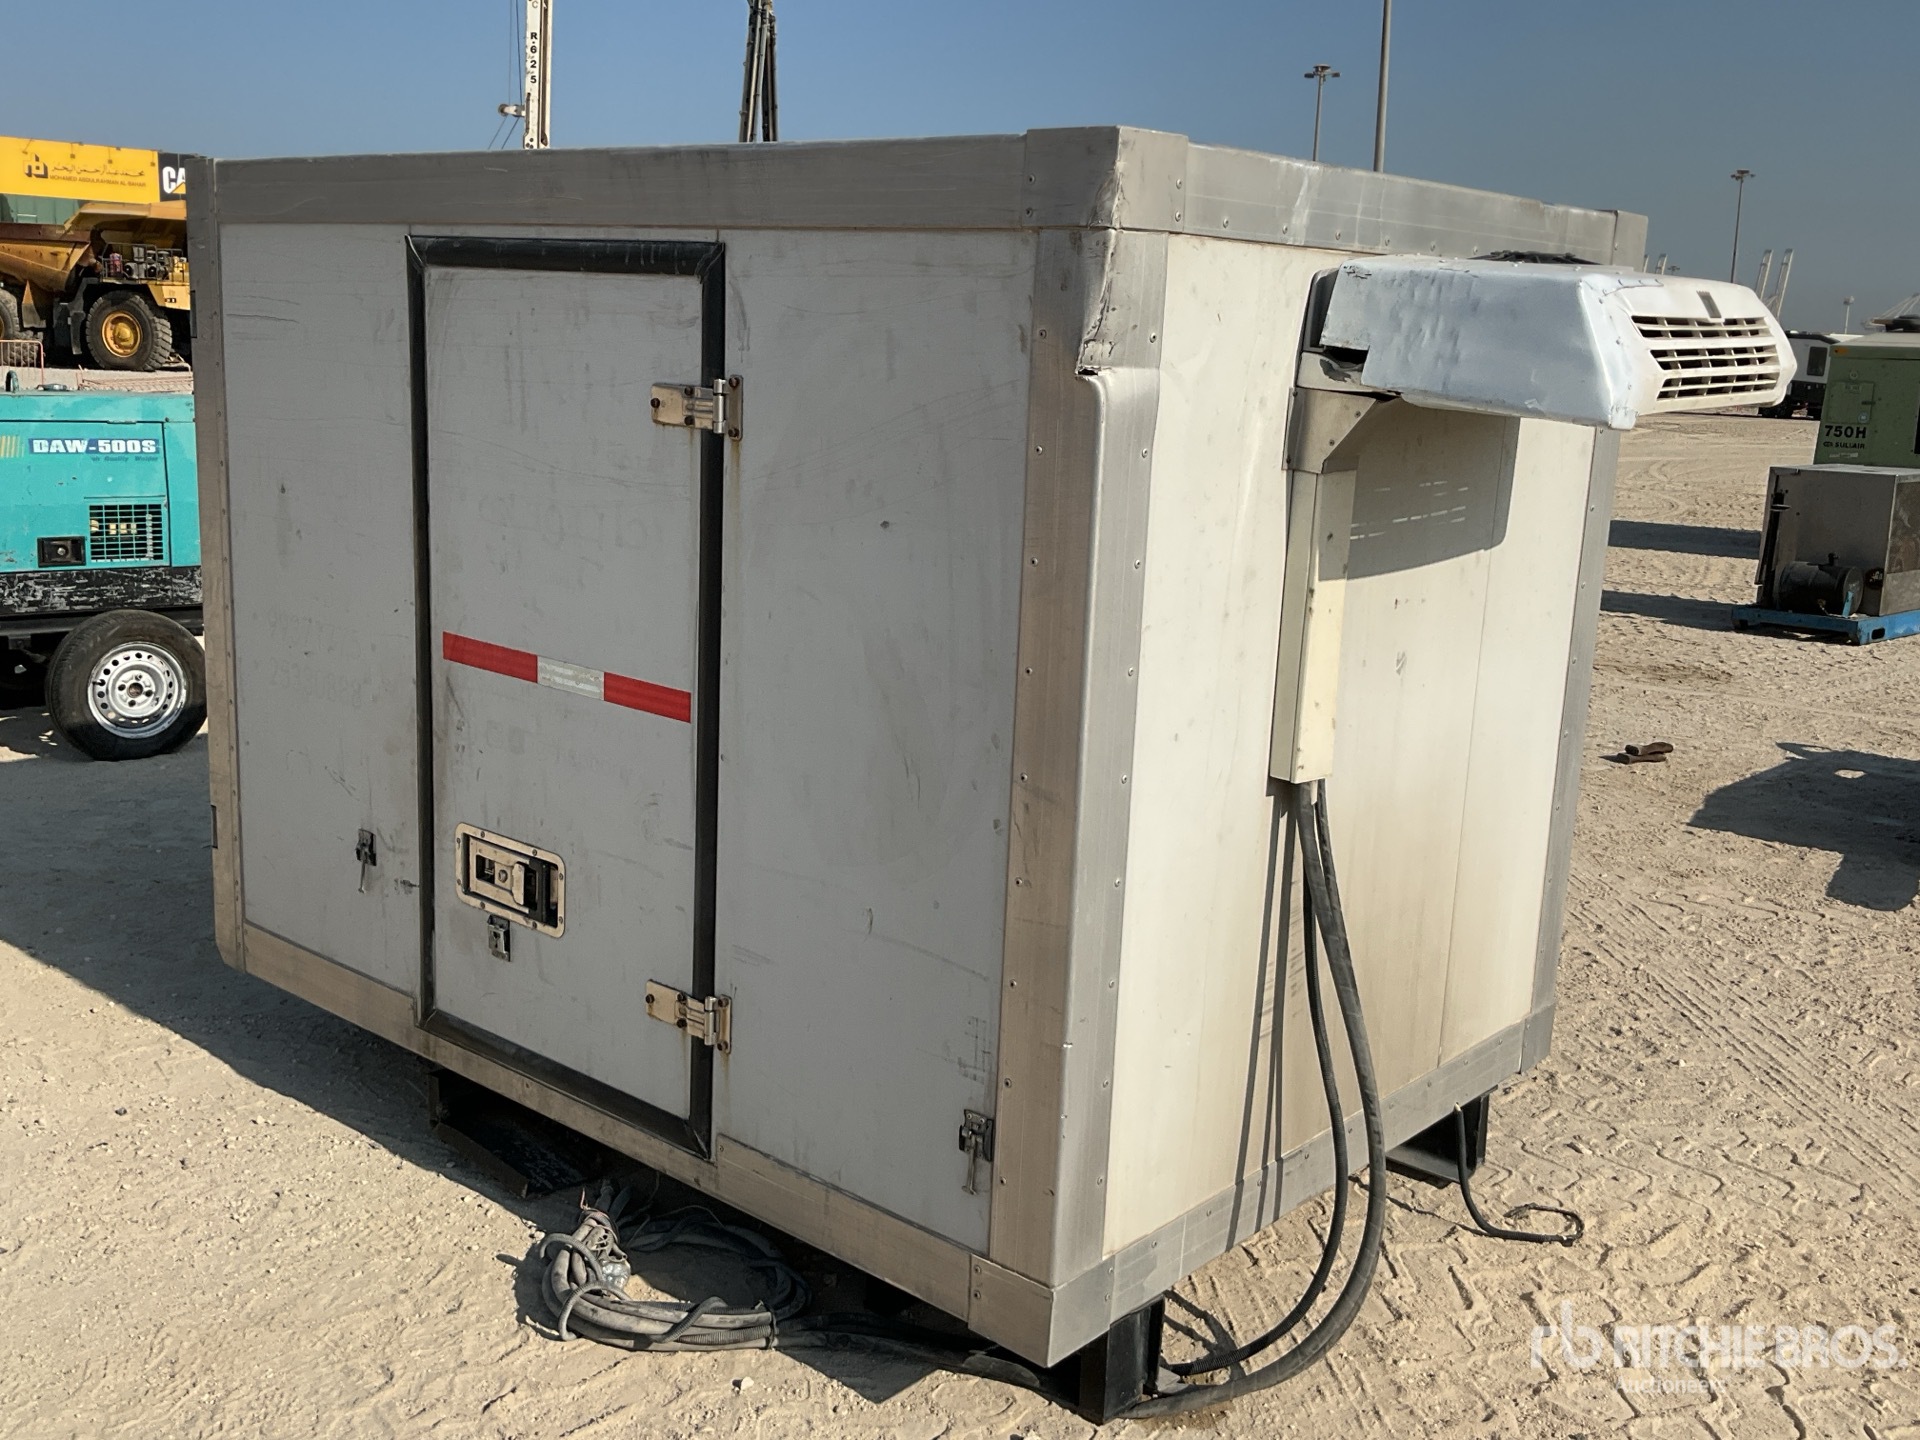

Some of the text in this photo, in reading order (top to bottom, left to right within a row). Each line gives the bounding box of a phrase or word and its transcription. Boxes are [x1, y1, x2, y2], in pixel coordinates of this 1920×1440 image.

[50, 174, 78, 182] MOHAMED
[162, 166, 186, 194] CA
[1825, 425, 1866, 438] 750H
[32, 439, 156, 453] DAW-500S
